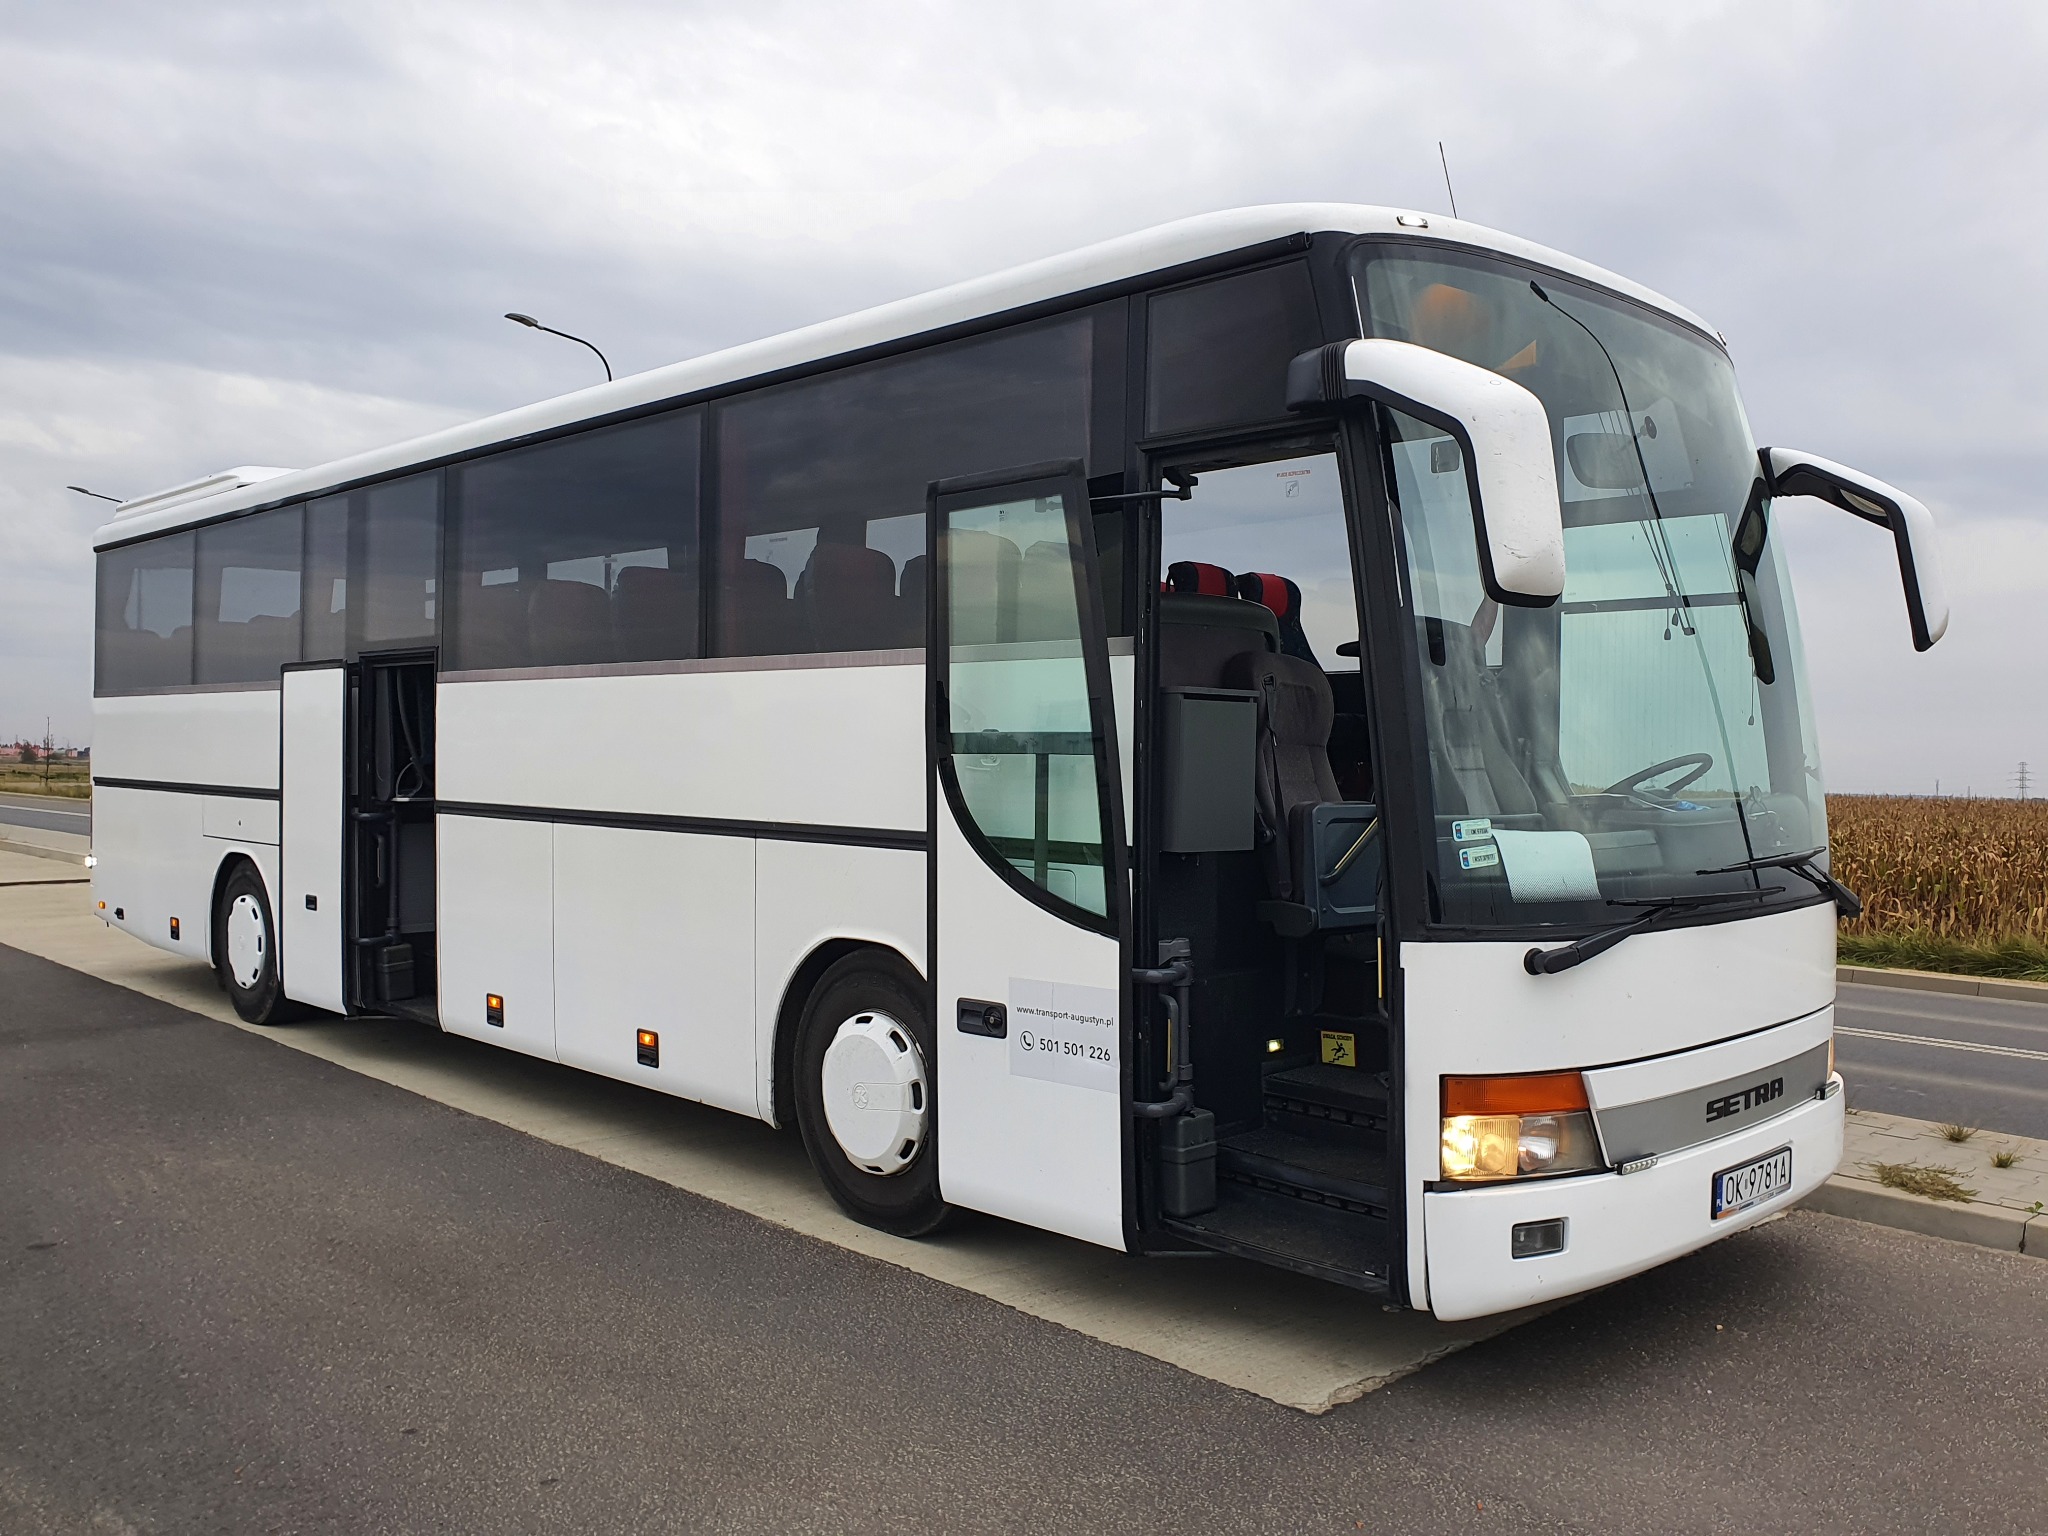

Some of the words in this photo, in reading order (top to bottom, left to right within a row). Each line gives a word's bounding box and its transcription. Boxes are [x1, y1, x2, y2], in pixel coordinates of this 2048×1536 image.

[1016, 1006, 1114, 1028] www.transport-augustyn.pl
[1039, 1037, 1059, 1053] 501
[1063, 1041, 1084, 1057] 501
[1088, 1045, 1111, 1062] 226
[1706, 1077, 1784, 1123] SETRA
